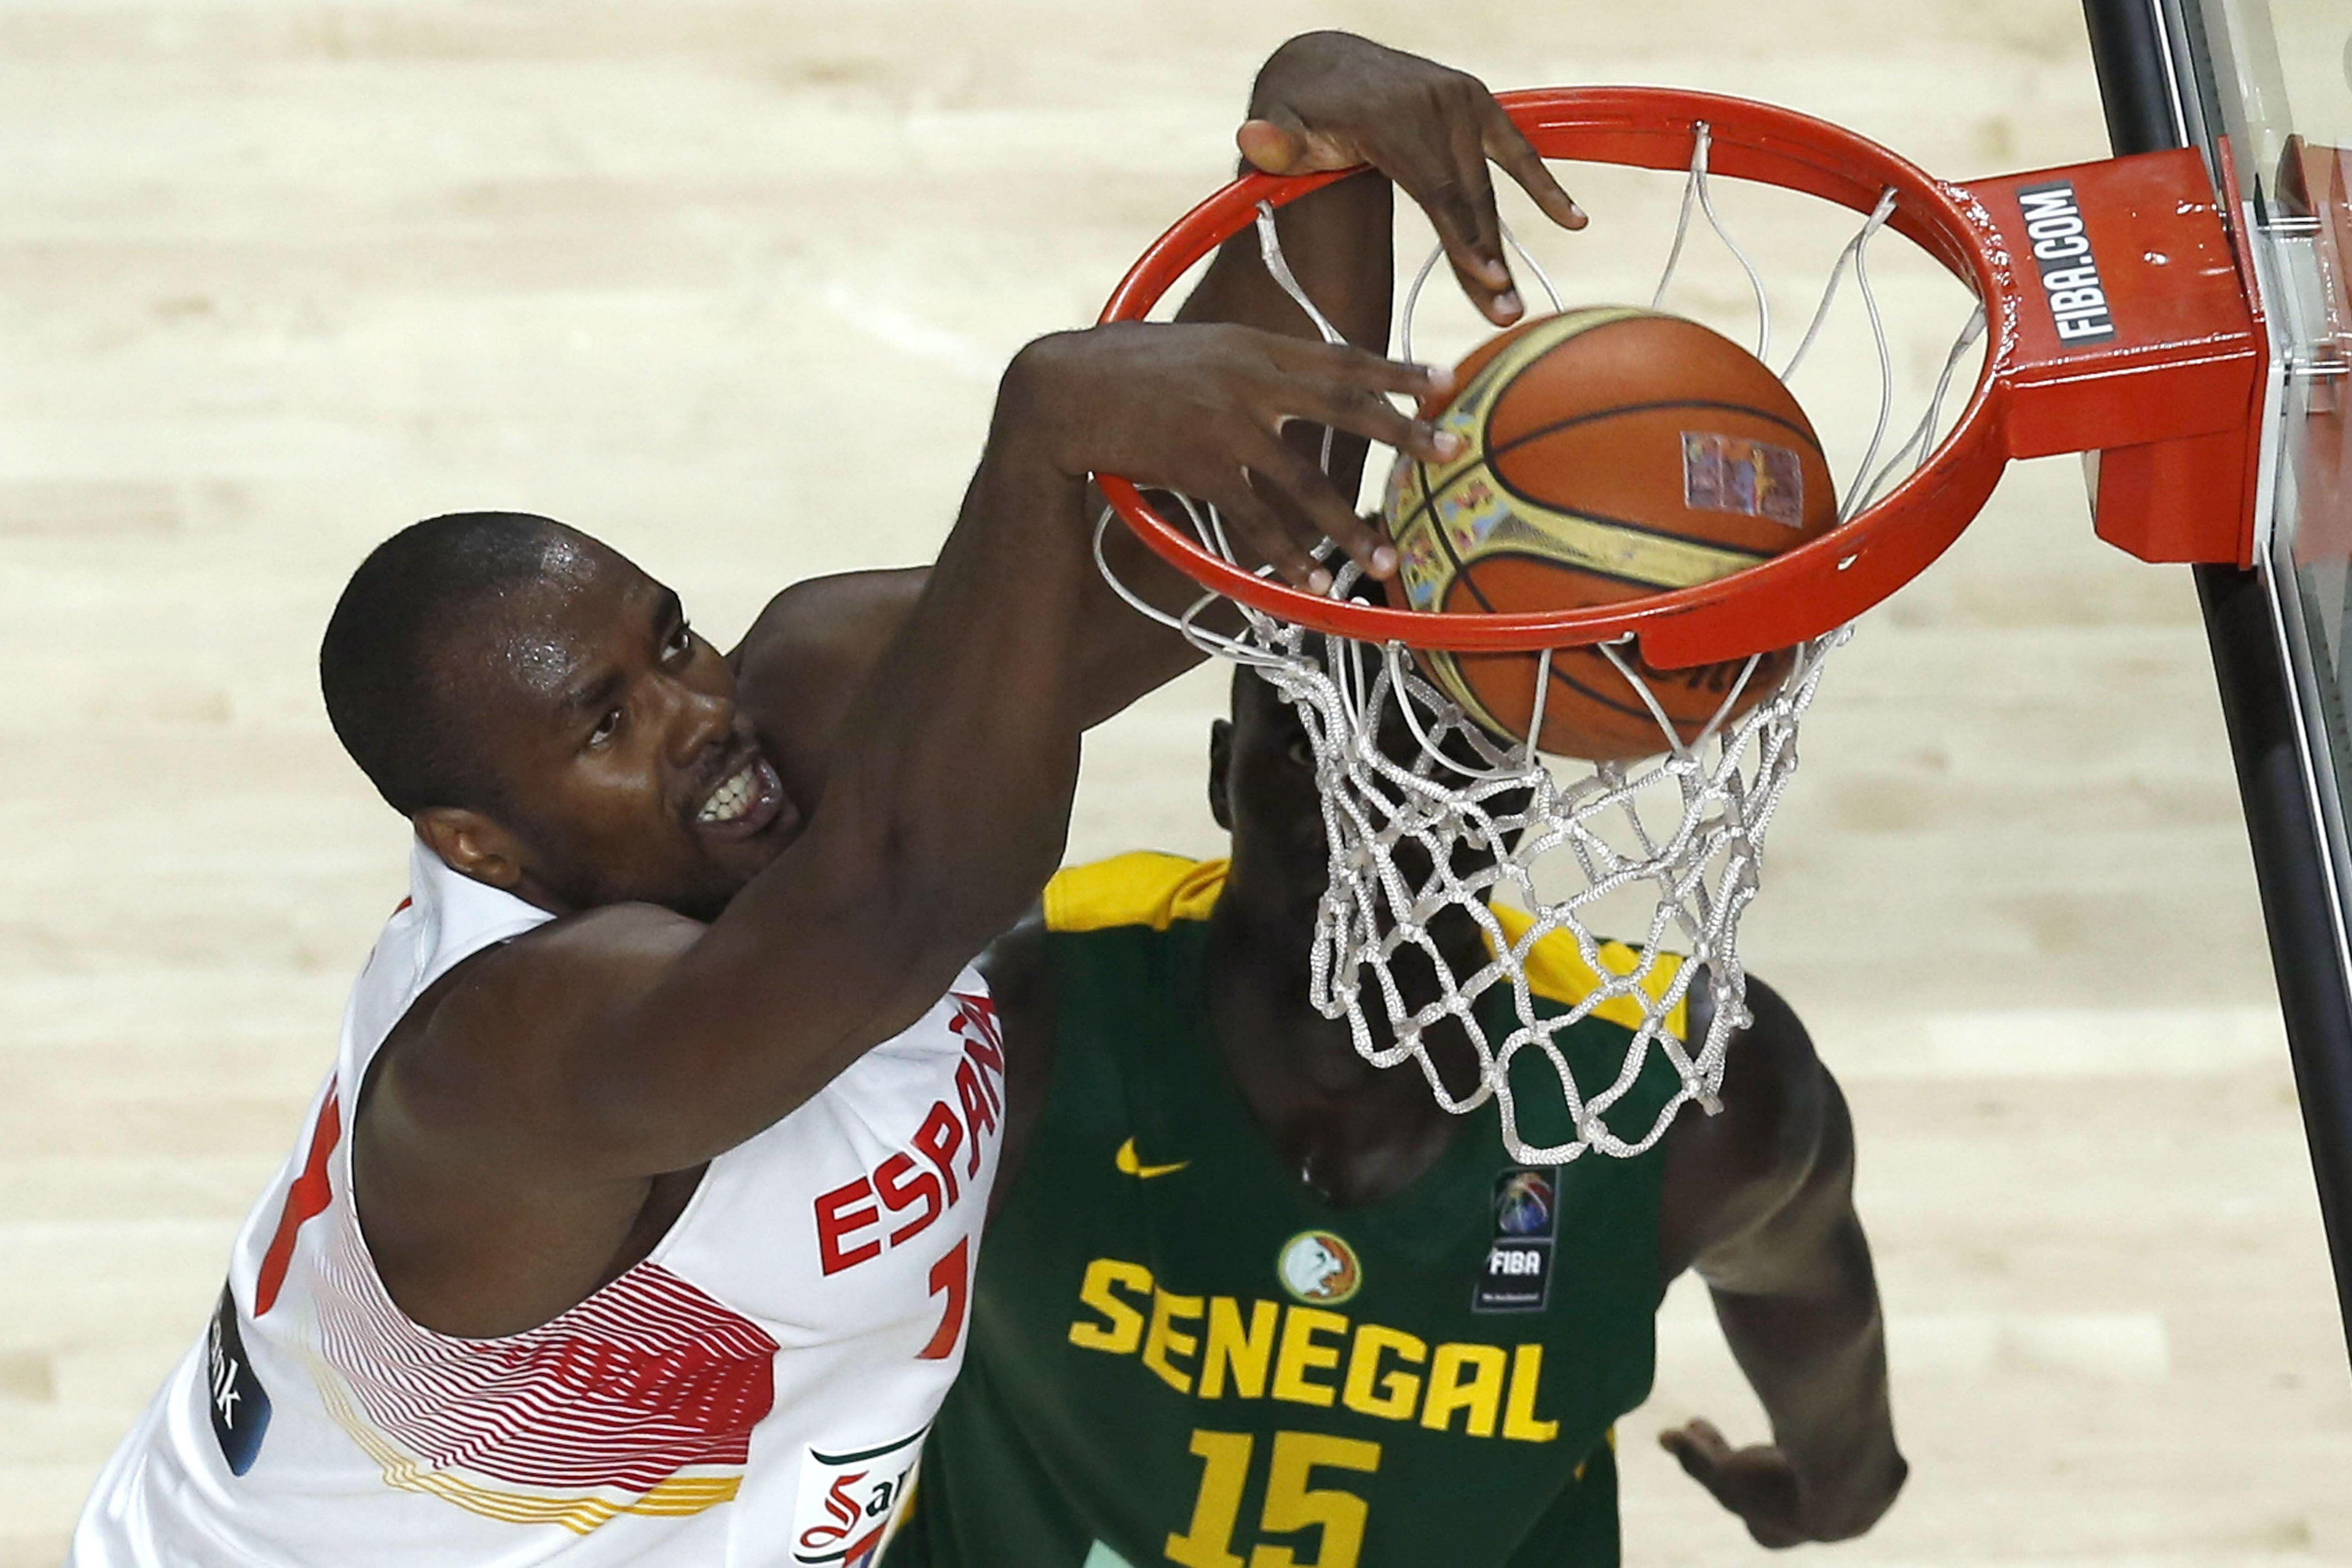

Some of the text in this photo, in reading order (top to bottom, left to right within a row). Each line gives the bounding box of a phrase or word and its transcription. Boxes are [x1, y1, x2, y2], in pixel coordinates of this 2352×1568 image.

[2019, 189, 2114, 339] FIBA.COM
[1490, 1250, 1541, 1275] FIBA
[212, 1301, 242, 1430] ank
[1069, 1258, 1559, 1442] SENEGAL
[1164, 1429, 1382, 1568] 15
